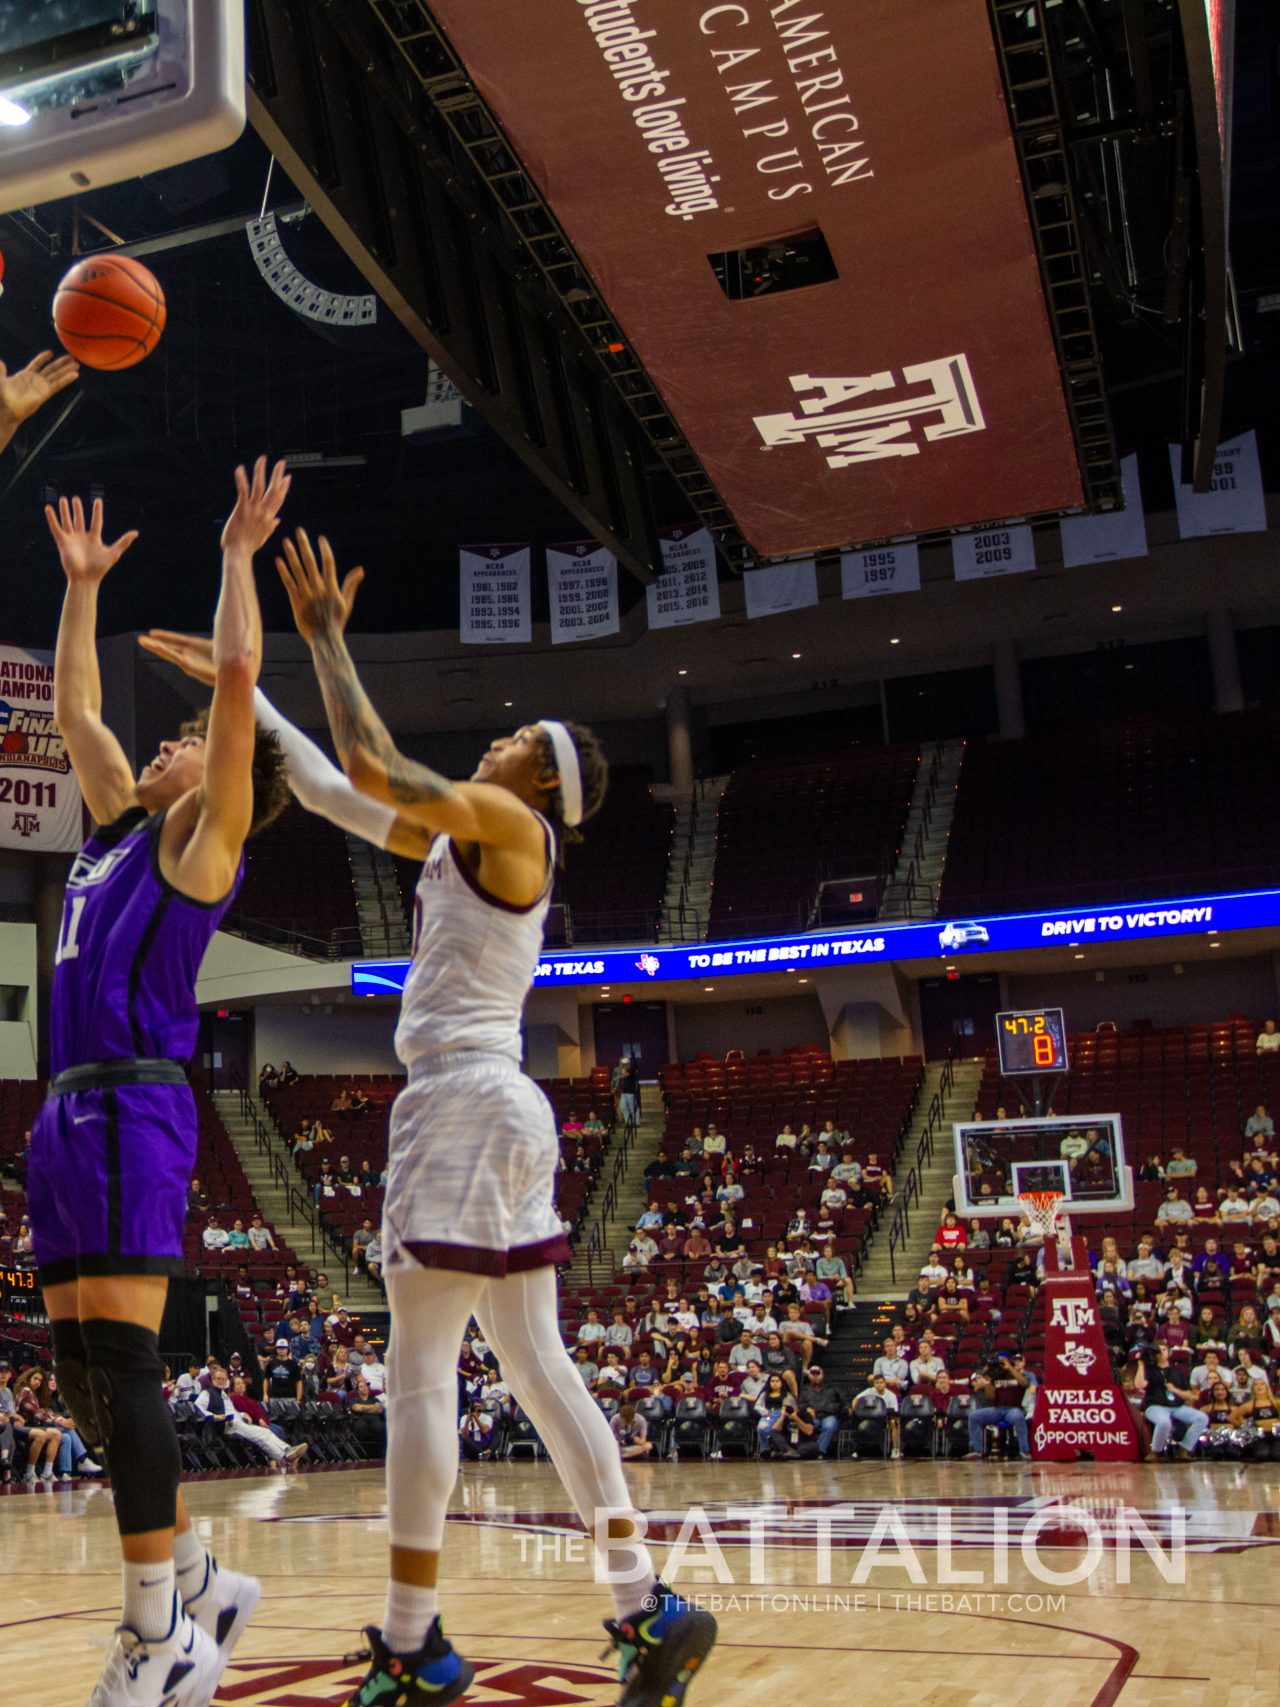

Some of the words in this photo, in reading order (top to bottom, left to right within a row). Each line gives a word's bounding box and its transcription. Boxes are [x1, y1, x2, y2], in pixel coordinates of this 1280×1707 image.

[580, 0, 671, 101] tudents
[699, 4, 813, 201] CAMPUS
[632, 97, 687, 154] love
[656, 150, 721, 221] living.
[1209, 477, 1236, 491] 001
[669, 543, 688, 551] NCAA
[974, 532, 1010, 549] 2003
[862, 552, 895, 568] 1995
[976, 547, 1012, 565] 2009
[864, 567, 896, 583] 1997
[1041, 916, 1095, 936] DRIVE
[1097, 915, 1123, 931] TO
[1126, 906, 1213, 929] VICTORY!
[688, 953, 710, 968] TO
[712, 952, 732, 967] BE
[735, 949, 766, 964] THE
[768, 945, 808, 962] BEST
[811, 943, 828, 959] IN
[831, 938, 886, 957] TEXAS
[554, 960, 604, 975] TEXAS
[1004, 1016, 1046, 1035] 47.2
[1033, 1034, 1055, 1066] 8
[1045, 1390, 1114, 1405] WELLS
[1048, 1408, 1116, 1424] FARGO
